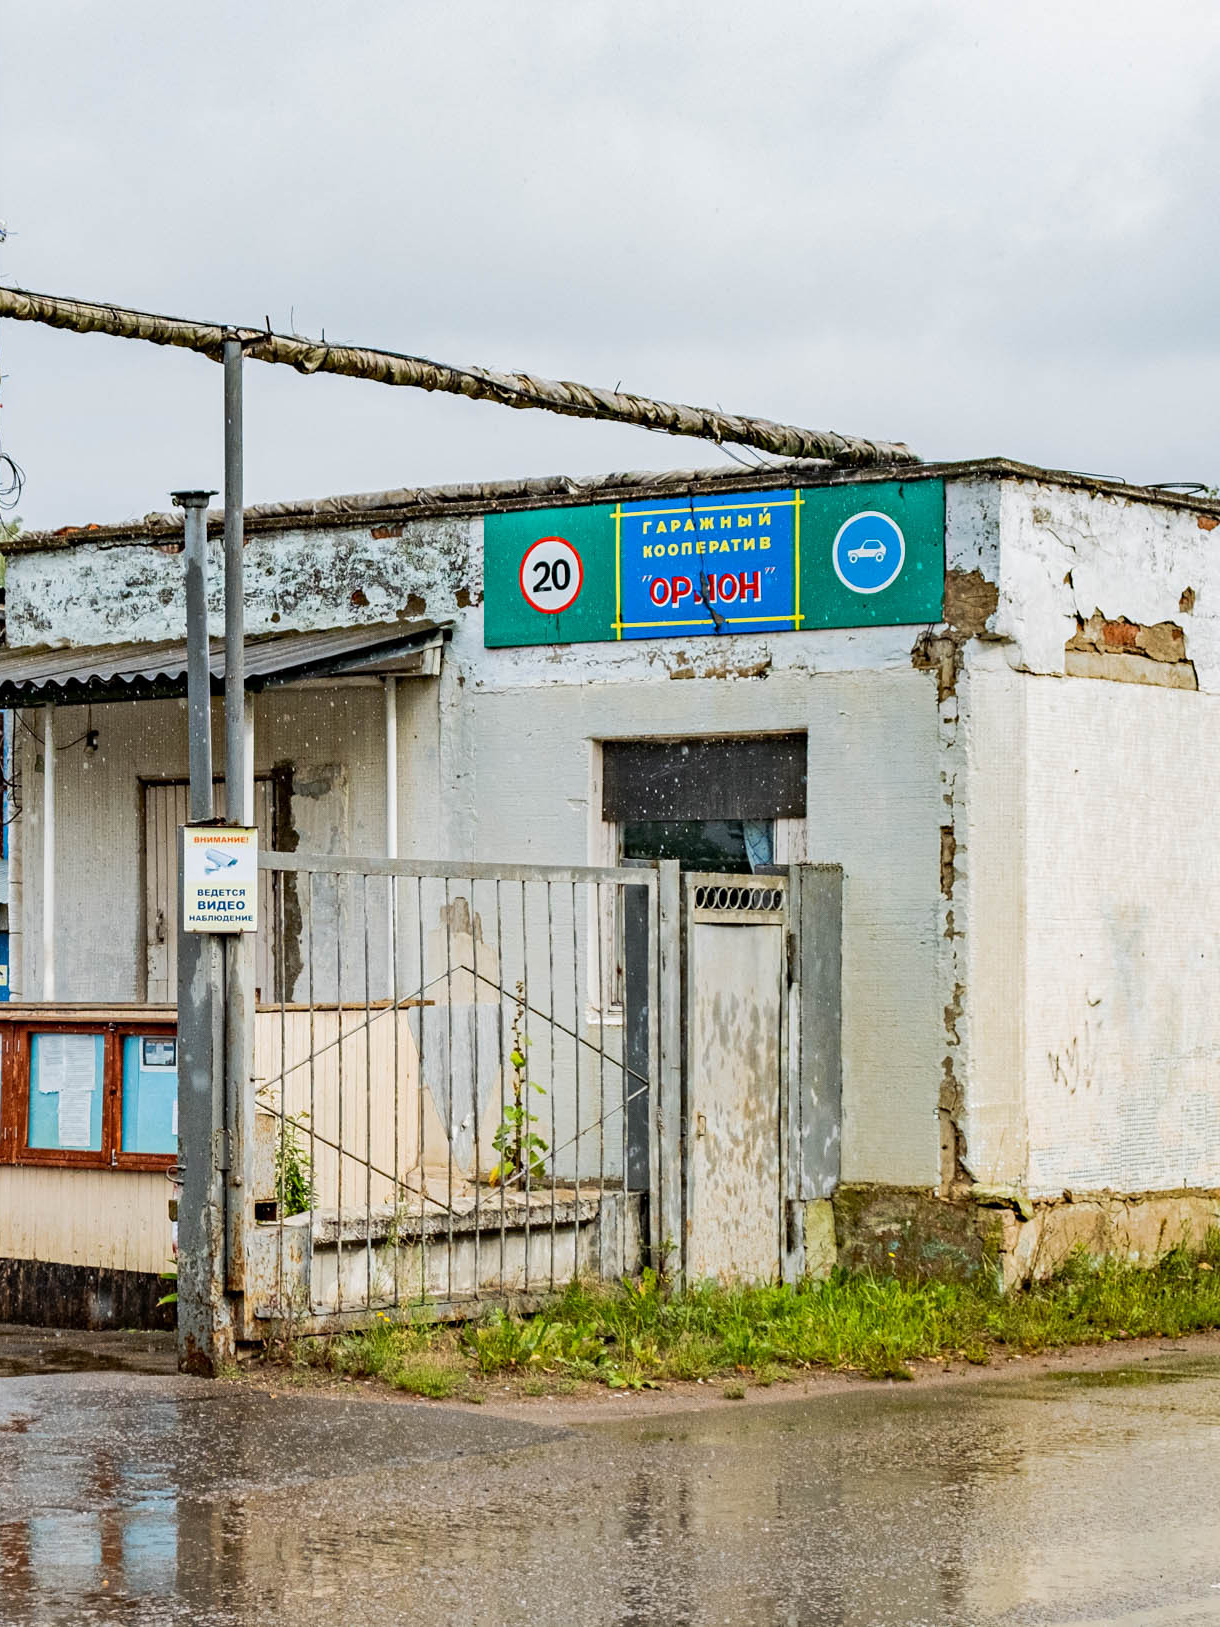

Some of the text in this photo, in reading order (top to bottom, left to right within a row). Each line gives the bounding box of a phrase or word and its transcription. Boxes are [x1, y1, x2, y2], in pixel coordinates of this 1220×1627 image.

[642, 507, 772, 535] ГАРАЖНЫЙ
[642, 536, 772, 559] КООПЕРАТИВ
[532, 558, 571, 593] 20
[193, 836, 249, 844] ВНИМАНИЕ!
[197, 888, 246, 898] ВЕДЕТСЯ
[197, 900, 246, 912] ВИДЕО
[188, 914, 254, 923] НАБЛЮДЕНИЕ
